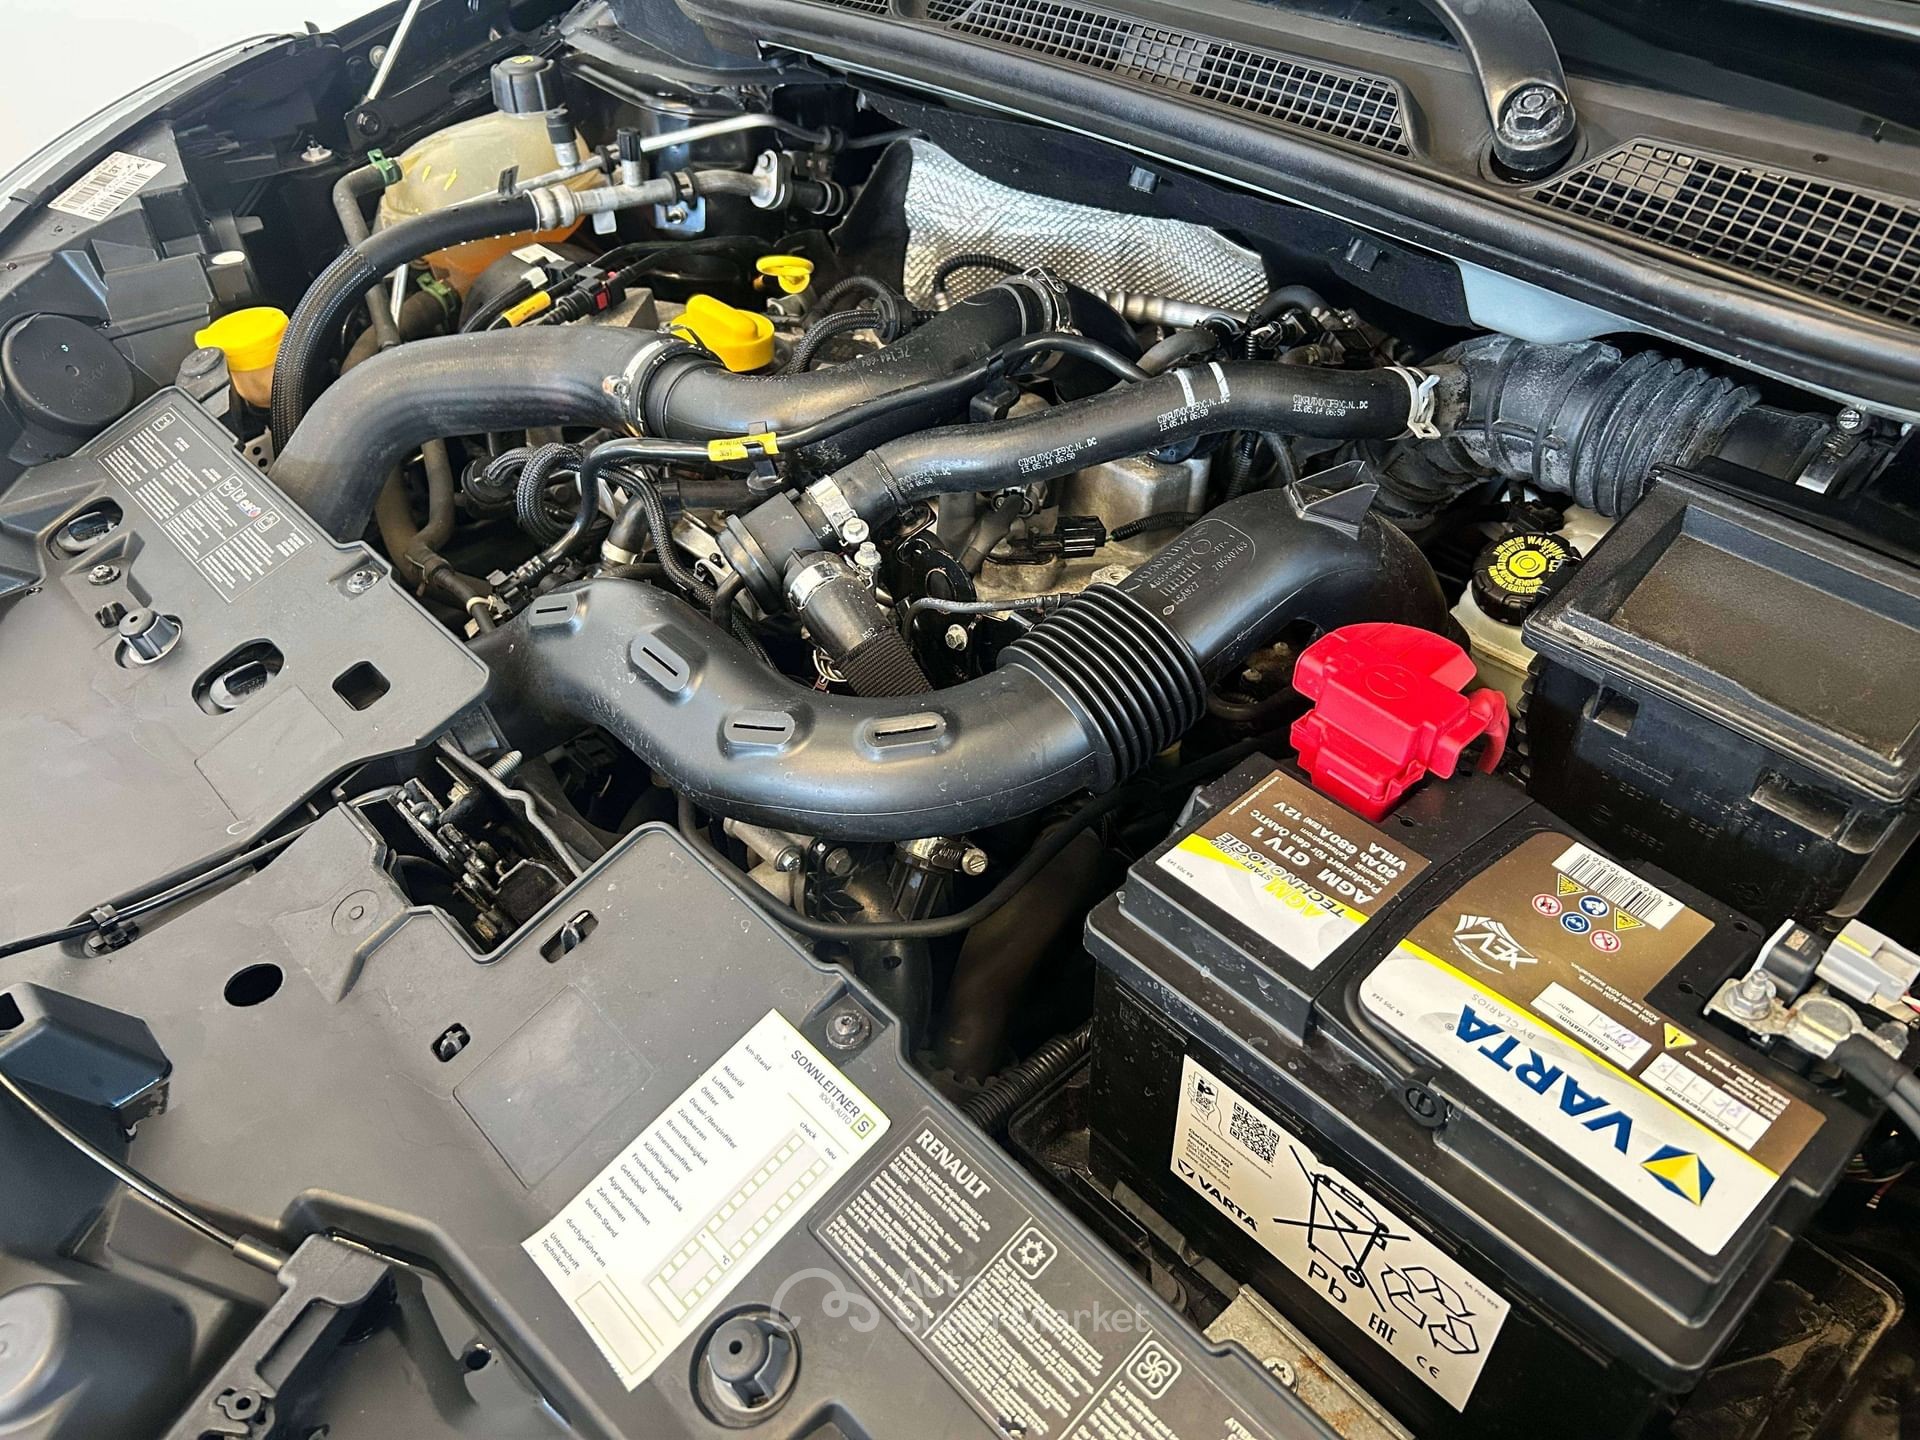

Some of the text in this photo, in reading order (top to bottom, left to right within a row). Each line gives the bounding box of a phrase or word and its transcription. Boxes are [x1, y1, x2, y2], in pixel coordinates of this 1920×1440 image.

[1527, 535, 1566, 560] WARNING
[1539, 546, 1552, 559] SEE
[1272, 798, 1302, 821] 12V
[1209, 837, 1273, 882] START STOPP
[1248, 806, 1383, 895] Produziert für den ÖAMTC
[1249, 822, 1374, 908] AGM GTV 1
[1298, 826, 1390, 886] Kapazität Kaltstartstrom
[1357, 850, 1399, 880] 60Ah
[1366, 840, 1408, 872] VRLA
[1215, 828, 1346, 918] TECHNOLOGIE
[1584, 852, 1675, 908] 4 016987 162361
[1261, 875, 1327, 926] AGM
[1588, 980, 1603, 993] und
[1601, 988, 1619, 1003] AGM
[1606, 984, 1624, 999] AGM
[1469, 992, 1536, 1040] BY CLARIOS
[1556, 1000, 1574, 1015] Jahr
[1637, 1011, 1656, 1027] AGM
[1641, 1007, 1660, 1022] AGM
[1555, 1012, 1610, 1052] Einbaudatum:
[1601, 1030, 1626, 1050] Monat
[722, 1064, 745, 1088] Motoröl
[743, 1043, 772, 1072] km-Stand
[699, 1085, 720, 1107] Ölfilter
[710, 1075, 735, 1101] Luftfilter
[789, 1048, 861, 1118] SONNLEITNER
[1447, 1002, 1642, 1155] VARTA
[676, 1107, 708, 1142] Zündkerzen
[688, 1095, 738, 1151] Diesel-/Benzinfilter
[818, 1091, 852, 1125] 100 % AUTO
[1662, 1082, 1731, 1132] Kilometerstand:
[664, 1118, 708, 1167] Bremsflüssigkeit
[798, 1120, 818, 1140] check
[641, 1140, 680, 1184] Kühlflüssigkeit
[653, 1129, 694, 1174] Innenraumfilter
[823, 1146, 837, 1160] neu
[913, 1127, 992, 1202] RENAULT
[619, 1163, 647, 1195] Getriebeöl
[630, 1151, 683, 1213] Frostschutzgehalt bis
[583, 1197, 619, 1238] bei km-Stand
[595, 1186, 628, 1222] Zahnriemen
[606, 1174, 652, 1227] Aggregateriemen
[1193, 1174, 1261, 1232] VARTA
[539, 1238, 573, 1276] Techniker:in
[548, 1232, 581, 1269] Unterschrift
[563, 1217, 607, 1267] durchgeführt am
[1302, 1259, 1353, 1305] Pb
